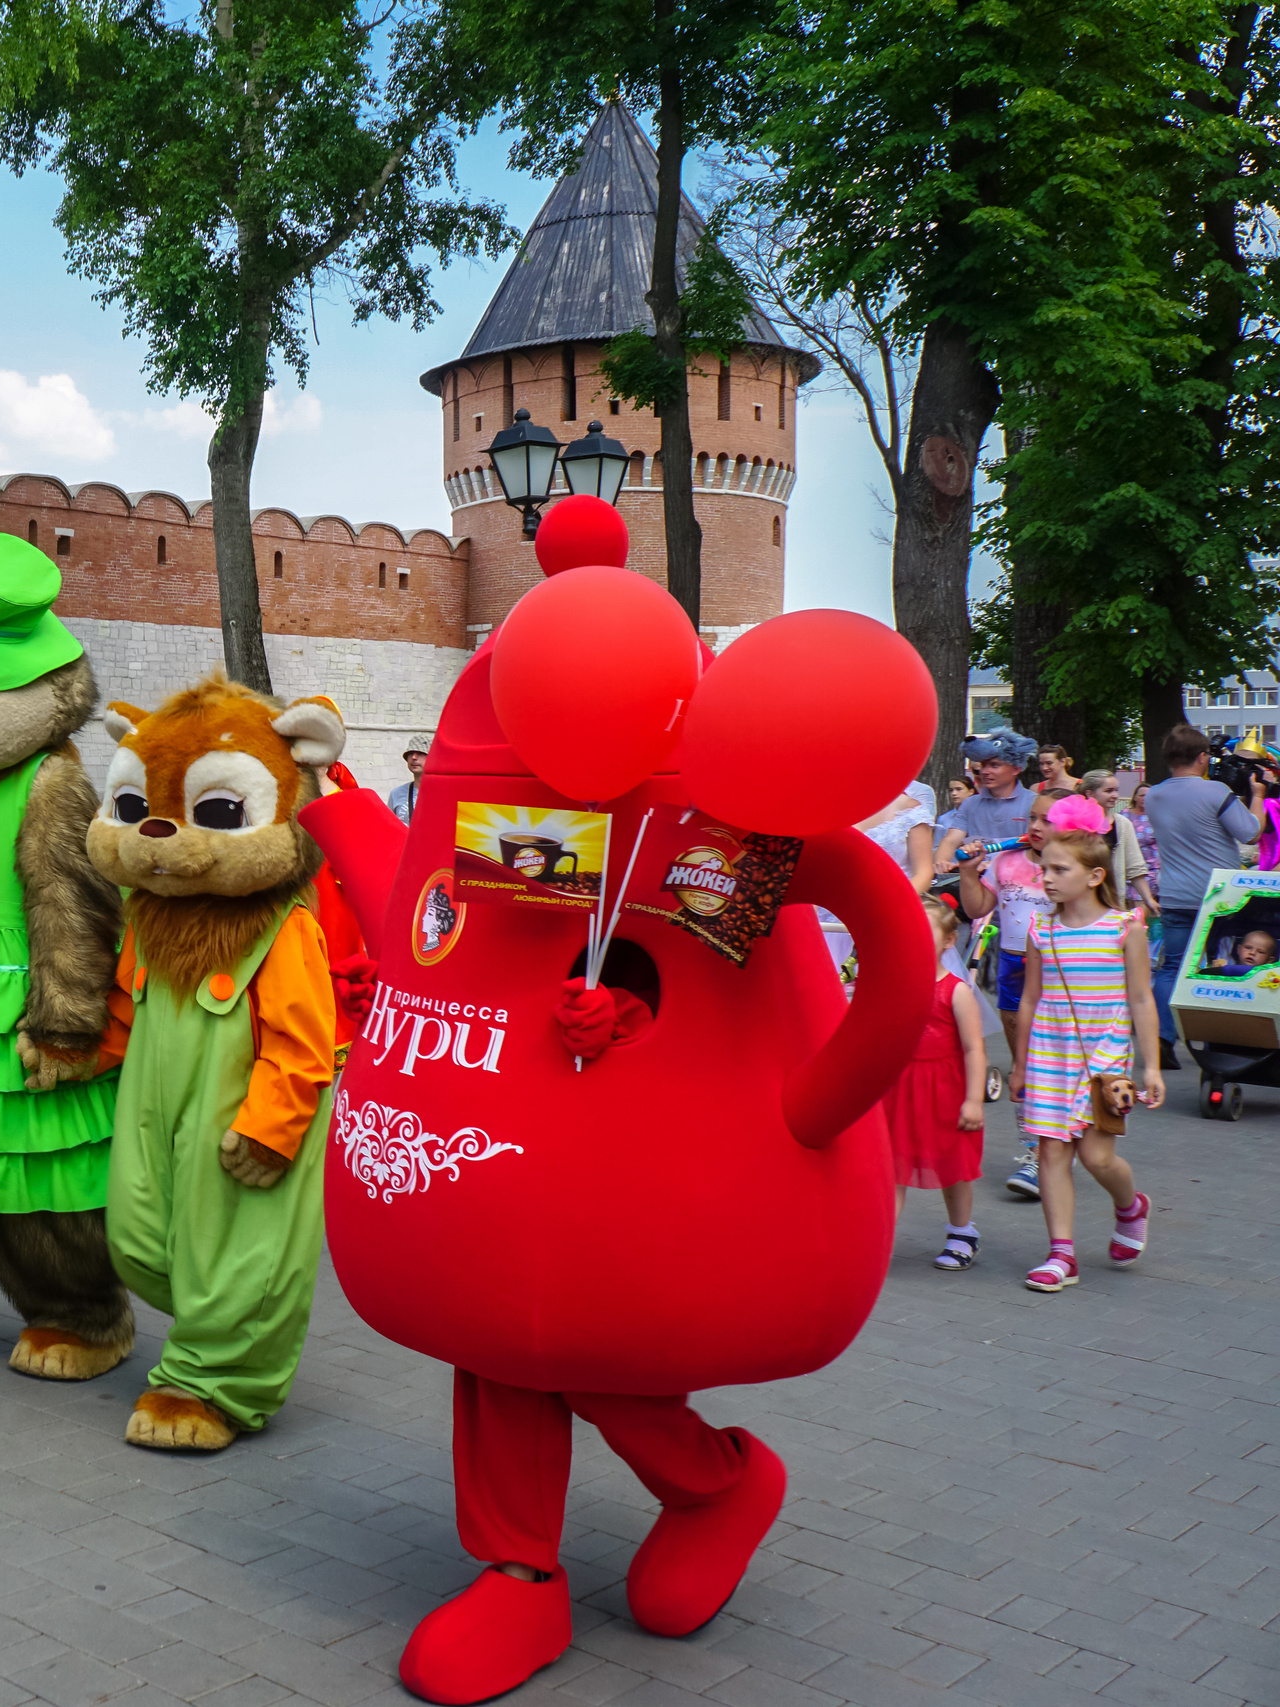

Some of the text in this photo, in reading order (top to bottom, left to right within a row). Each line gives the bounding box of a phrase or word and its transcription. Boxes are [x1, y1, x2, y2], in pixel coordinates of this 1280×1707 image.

[513, 855, 545, 869] ЖОКЕЙ
[459, 879, 528, 892] С ПРАЗДНИКОМ,
[665, 866, 737, 896] ЖОКЕЙ
[1238, 877, 1280, 887] КУКЛ
[513, 894, 593, 908] ЛЮБИМЫЙ ГОРОД!
[631, 903, 686, 924] ПРАЗДНИКОМ,
[687, 920, 721, 946] ЛЮБИМЫЙ
[720, 943, 745, 963] ГОРОД!
[1196, 987, 1253, 1000] ЕГОРКА
[393, 990, 509, 1024] принцесса
[361, 980, 506, 1077] Нури
